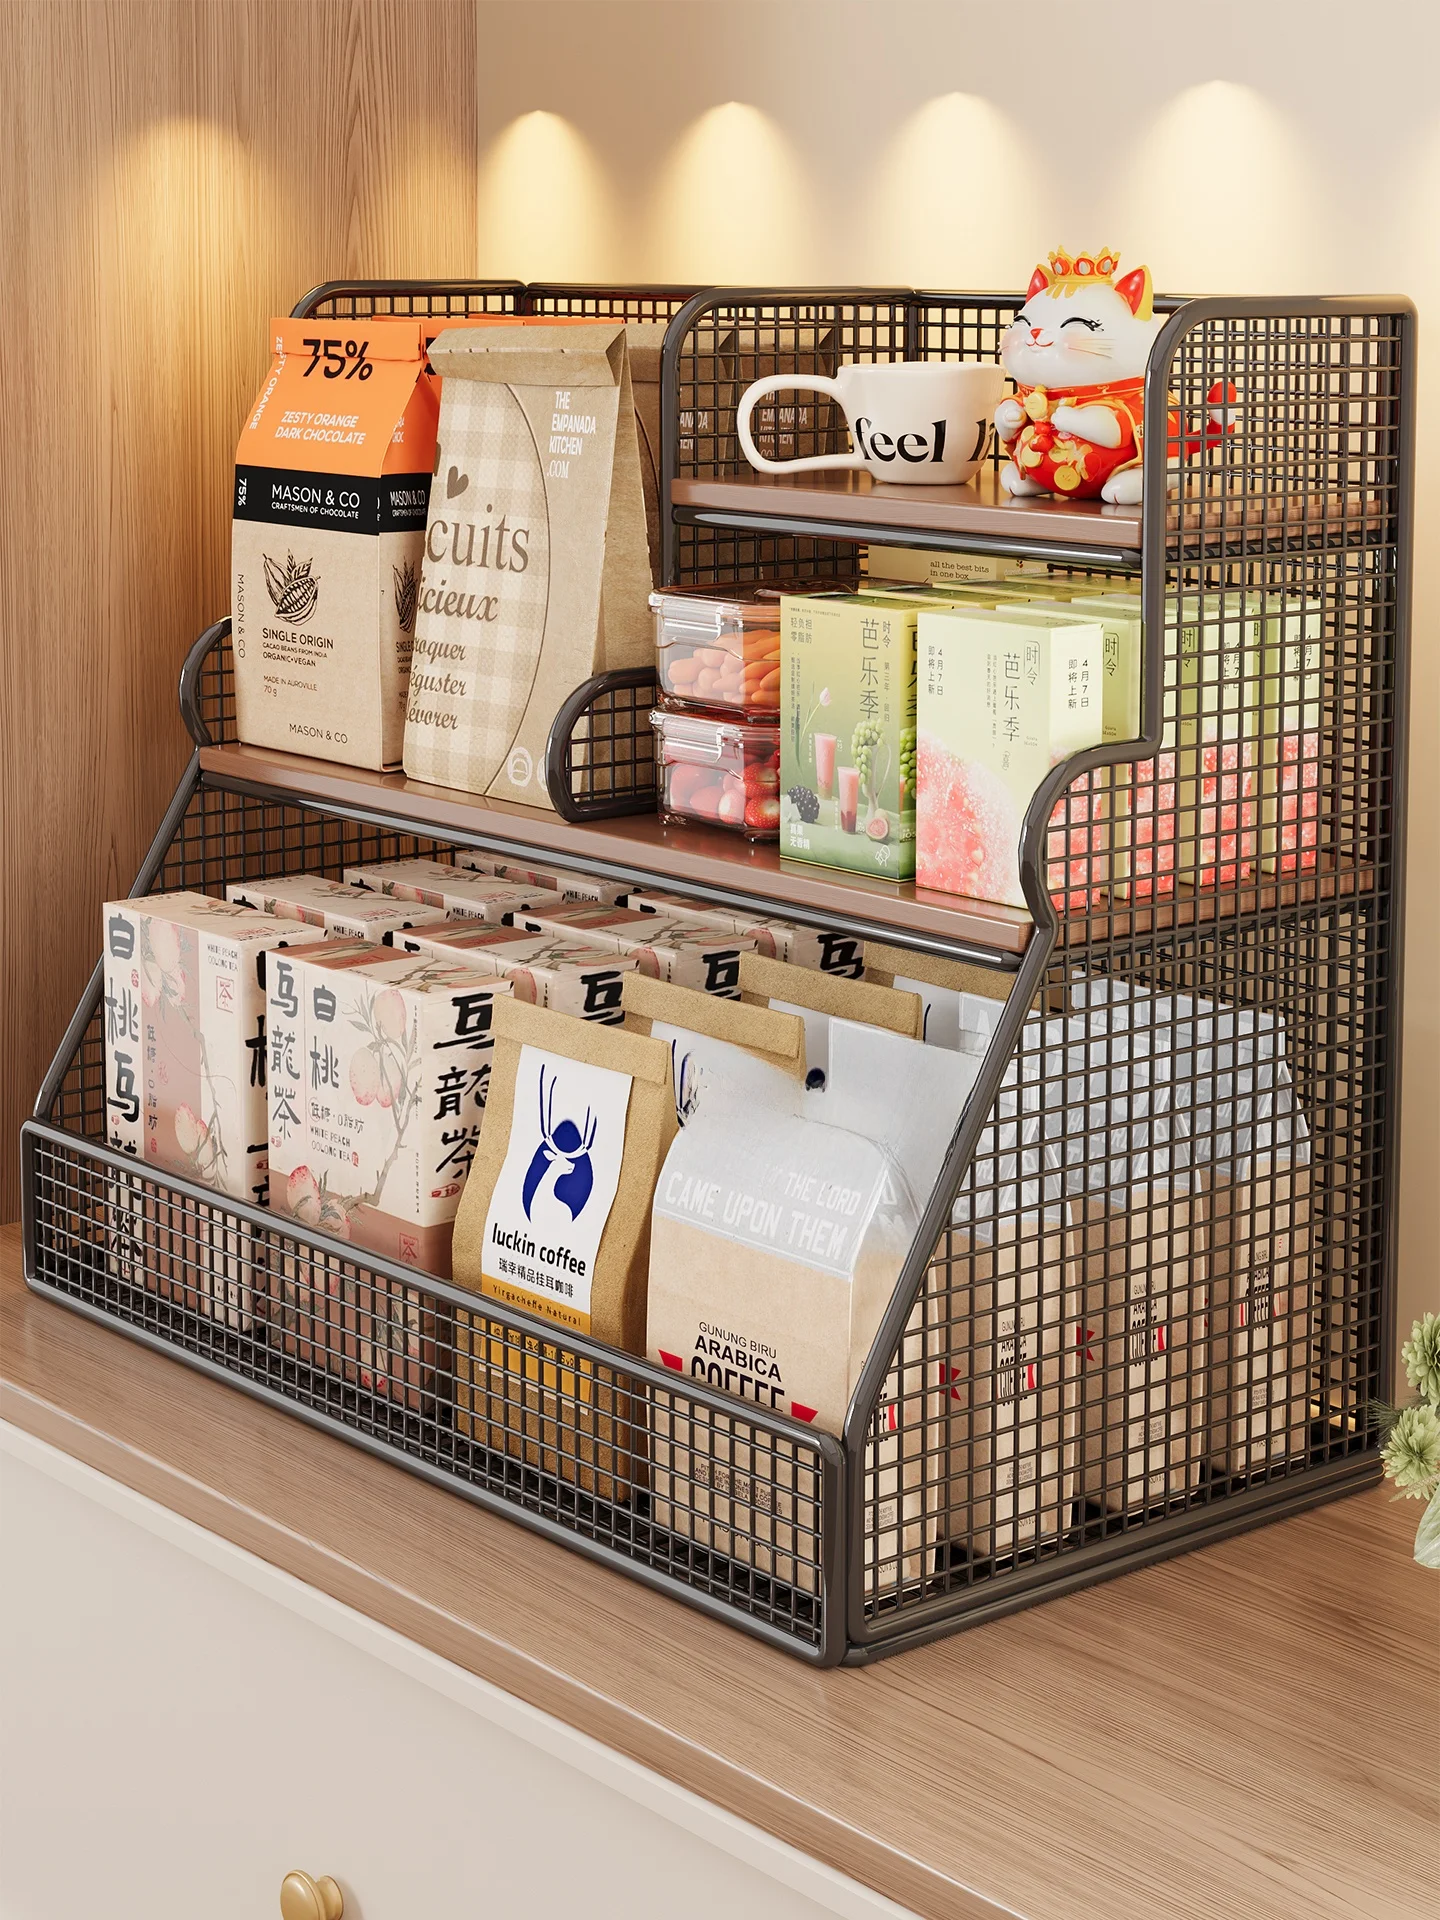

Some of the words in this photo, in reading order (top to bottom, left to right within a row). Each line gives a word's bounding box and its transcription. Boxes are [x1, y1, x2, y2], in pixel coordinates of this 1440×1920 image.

[302, 338, 373, 381] 75%
[249, 377, 278, 430] ORANGE
[555, 391, 571, 409] THE
[281, 411, 314, 425] ZESTY
[314, 412, 359, 428] ORANGE
[551, 413, 596, 434] EMPANADA
[274, 426, 303, 440] DARK
[303, 428, 366, 445] CHOCOLATE
[549, 435, 583, 456] KITCHEN
[855, 416, 947, 463] feel
[547, 460, 570, 478] .COM
[238, 478, 247, 506] 75%
[271, 484, 322, 504] MASON
[325, 490, 335, 506] &
[339, 491, 360, 508] CO
[390, 490, 412, 506] MASON
[418, 489, 426, 505] CO
[271, 501, 309, 513] CRAFTSMEN
[309, 506, 319, 514] OF
[320, 507, 359, 519] CHOCOLATE
[426, 503, 531, 574] cuits
[930, 560, 940, 568] all
[941, 561, 955, 569] the
[956, 562, 973, 572] best
[974, 564, 989, 574] bits
[930, 569, 938, 577] in
[940, 570, 953, 579] one
[955, 571, 969, 580] box
[237, 573, 245, 622] MASON
[417, 576, 499, 622] icieux
[237, 626, 245, 634] &
[262, 627, 297, 644] SINGLE
[299, 633, 334, 650] ORIGIN
[882, 620, 891, 649] 时令
[238, 638, 246, 659] CO
[262, 642, 281, 651] CACAO
[281, 644, 298, 653] BEANS
[298, 647, 314, 656] FROM
[314, 650, 328, 659] INDIA
[1105, 637, 1117, 677] 时令
[859, 618, 880, 720] 芭乐季
[1026, 646, 1038, 686] 时令
[263, 674, 280, 685] MADE
[280, 678, 287, 686] IN
[264, 685, 272, 694] 70
[272, 688, 278, 697] g
[1068, 658, 1077, 709] 即将上新
[1080, 658, 1089, 708] 4月7日
[1003, 652, 1021, 742] 芭乐季
[289, 723, 324, 739] MASON
[325, 731, 332, 740] &
[334, 732, 348, 744] CO
[565, 890, 582, 901] WHITE
[582, 891, 599, 902] PEACH
[452, 906, 468, 918] WHITE
[468, 909, 485, 921] PEACH
[333, 924, 348, 937] WHITE
[348, 928, 365, 939] PEACH
[207, 944, 222, 956] WHITE
[222, 947, 238, 960] PEACH
[309, 984, 340, 1091] 白桃
[310, 1124, 329, 1140] WHITE
[330, 1130, 351, 1147] PEACH
[311, 1140, 337, 1157] OOLONG
[338, 1147, 351, 1162] TEA
[783, 1172, 816, 1201] THE
[815, 1180, 862, 1216] LORD
[665, 1171, 722, 1220] CAME
[722, 1191, 784, 1240] UPON
[785, 1210, 848, 1261] THEM
[492, 1222, 536, 1258] luckin
[539, 1244, 586, 1277] coffee
[498, 1257, 574, 1298] 瑞幸精品挂耳咖啡
[546, 1305, 581, 1326] Natural
[698, 1321, 747, 1348] GUNUNG
[750, 1339, 777, 1359] BIRU
[694, 1335, 782, 1382] ARABICA
